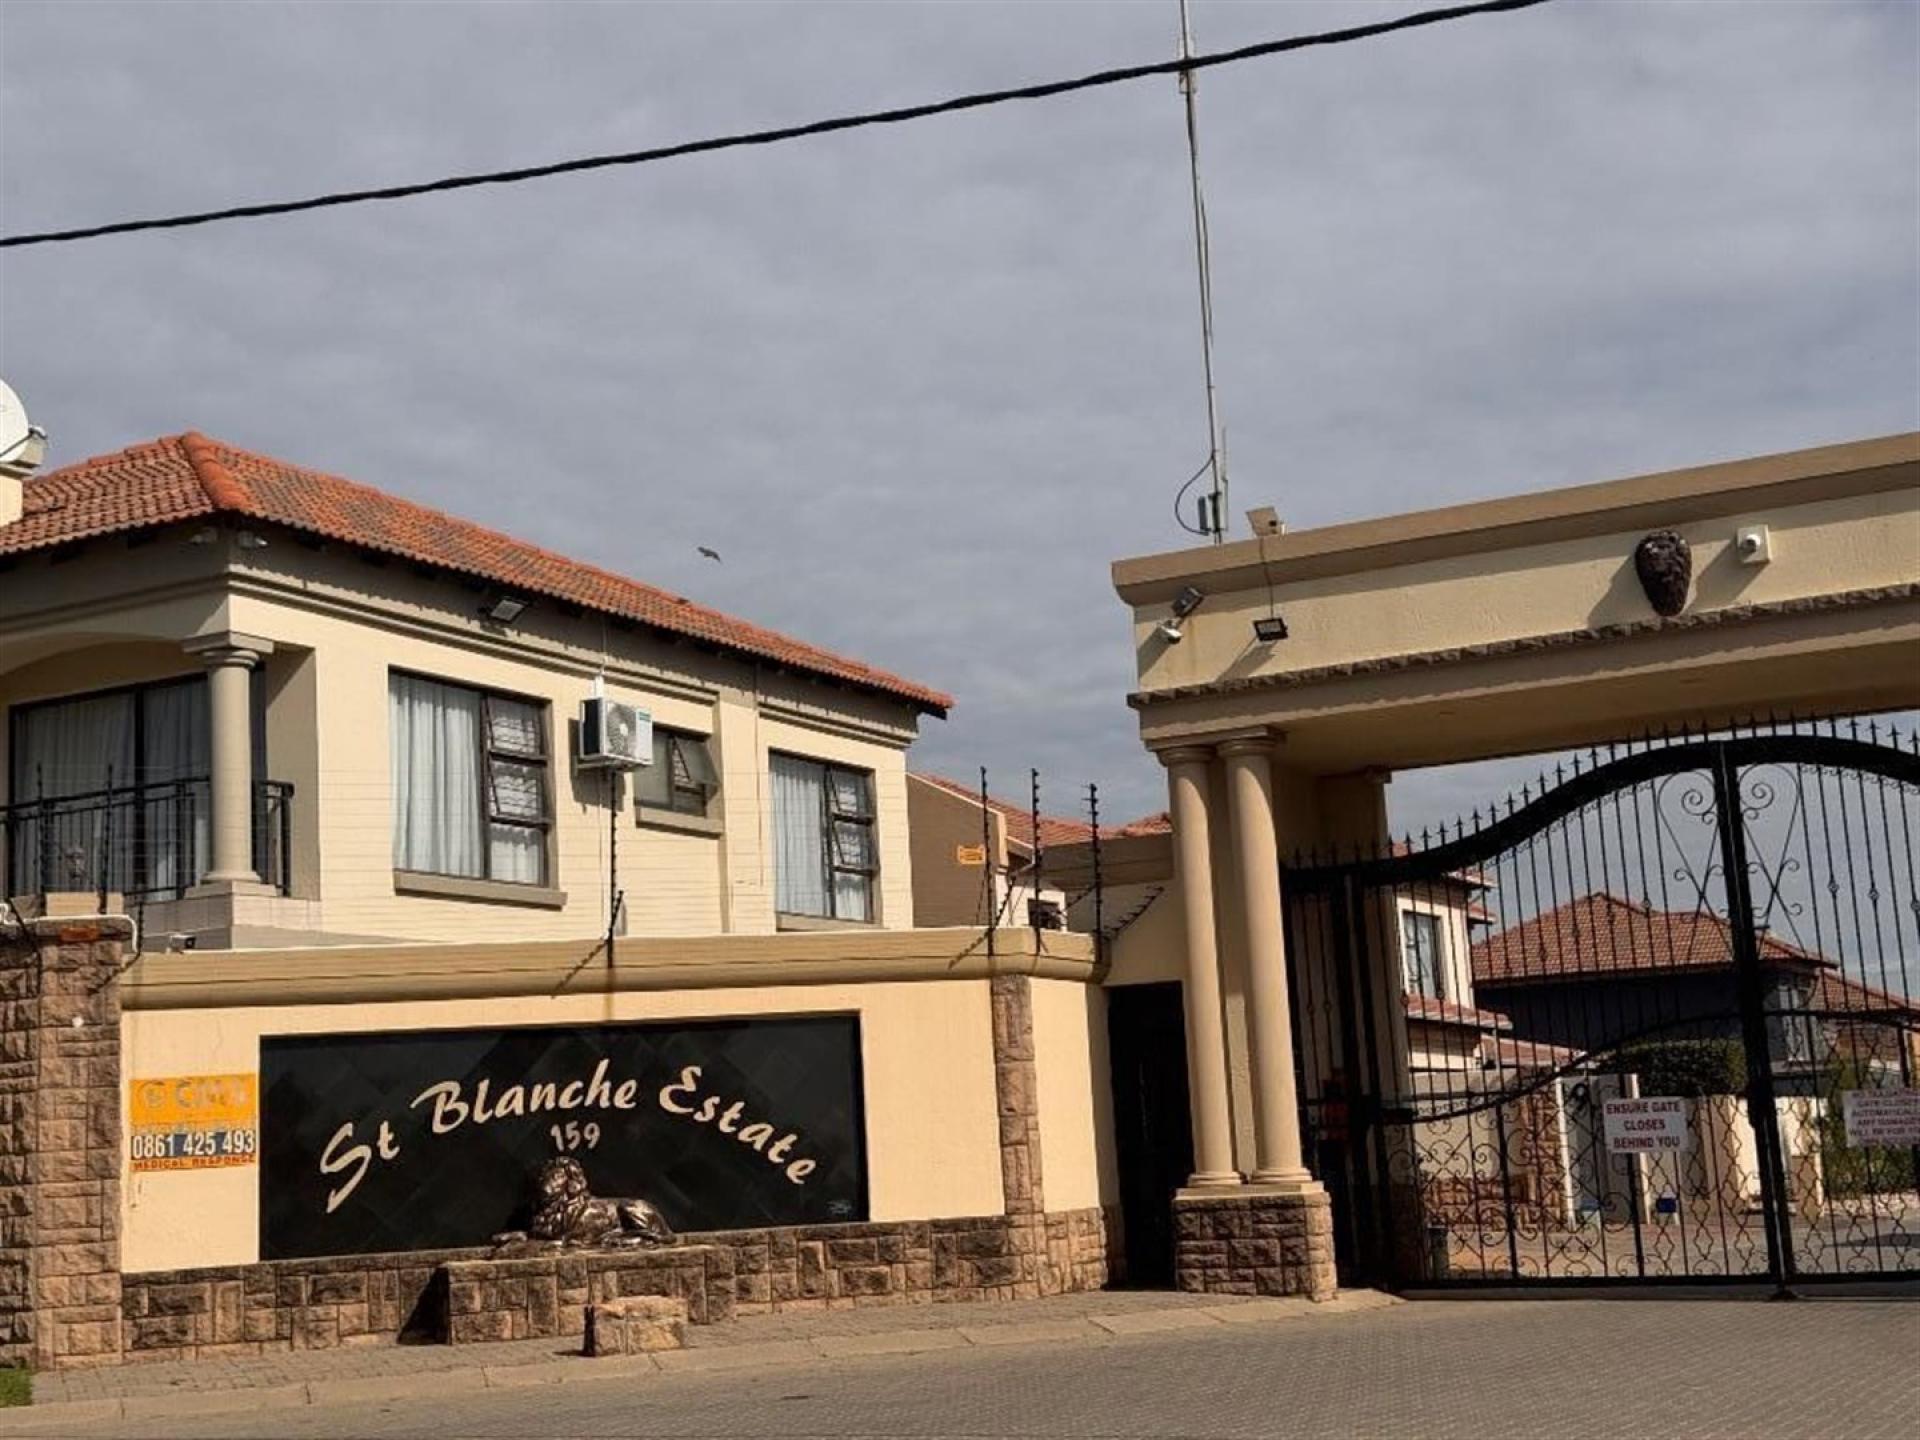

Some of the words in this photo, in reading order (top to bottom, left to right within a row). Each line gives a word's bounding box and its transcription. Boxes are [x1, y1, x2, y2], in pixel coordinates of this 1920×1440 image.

[1607, 1102, 1648, 1114] ENSURE
[1652, 1101, 1680, 1112] GATE
[320, 1121, 401, 1213] St
[409, 1058, 638, 1135] Blanche
[658, 1065, 817, 1185] Estate
[1624, 1119, 1665, 1131] CLOSES
[132, 1134, 175, 1158] 0861
[182, 1130, 216, 1156] 425
[221, 1128, 254, 1154] 493
[550, 1121, 602, 1153] 159
[1614, 1138, 1654, 1149] BEHIND
[1656, 1136, 1680, 1147] YOU
